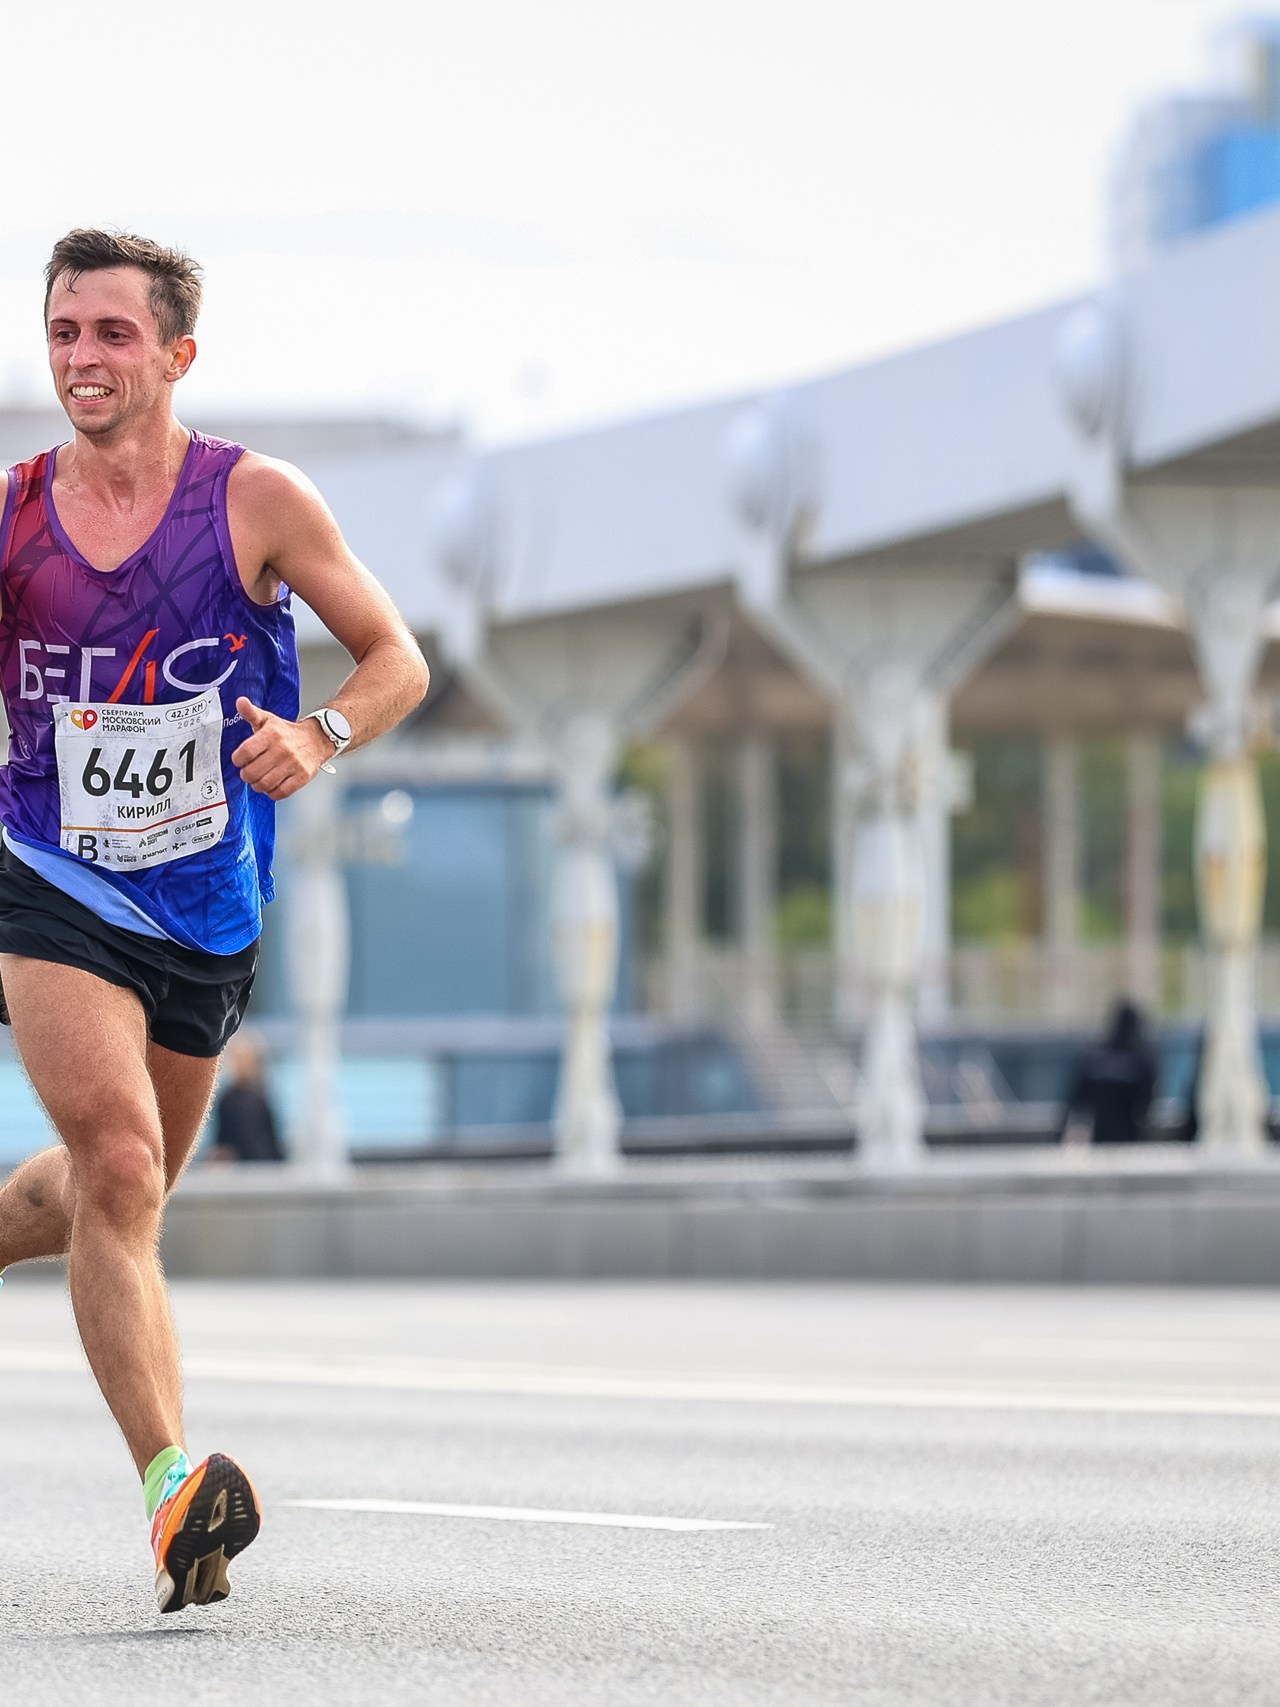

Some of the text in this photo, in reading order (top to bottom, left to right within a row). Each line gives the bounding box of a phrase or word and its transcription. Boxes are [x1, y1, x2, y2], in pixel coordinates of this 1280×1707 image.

[171, 703, 203, 718] 42,2 КМ
[102, 716, 161, 725] МОСКОВСКИЙ
[102, 724, 146, 733] МАРАФОН
[82, 739, 196, 798] 6461
[206, 785, 213, 795] 3
[117, 798, 171, 819] КИРИЛЛ
